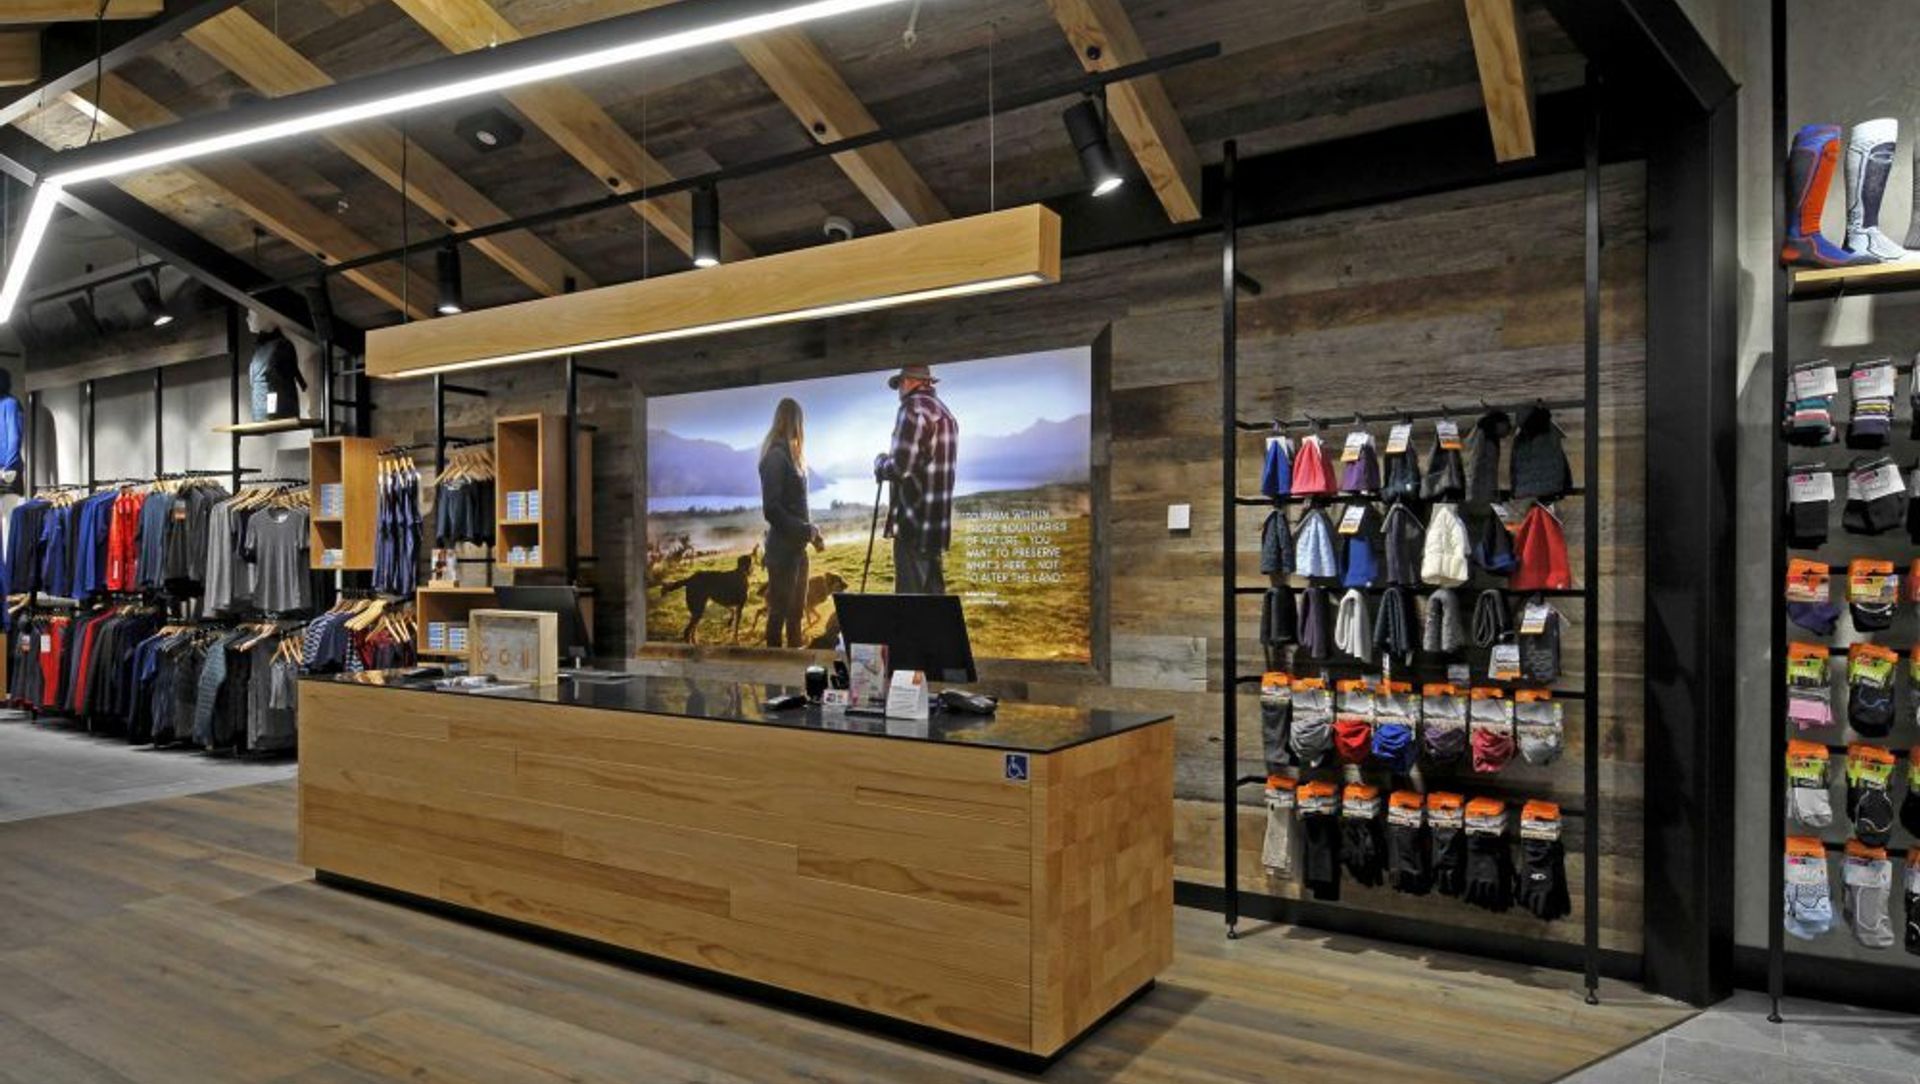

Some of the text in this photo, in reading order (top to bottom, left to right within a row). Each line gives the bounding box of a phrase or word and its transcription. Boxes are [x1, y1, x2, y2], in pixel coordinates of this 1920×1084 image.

[1000, 521, 1067, 533] BOUNDARIES
[1031, 534, 1050, 545] YOU
[966, 547, 1061, 558] WANT TO PRESERVE
[1038, 560, 1059, 570] NOT
[966, 573, 978, 583] TO
[981, 573, 1009, 583] ALTER
[1012, 573, 1030, 583] THE
